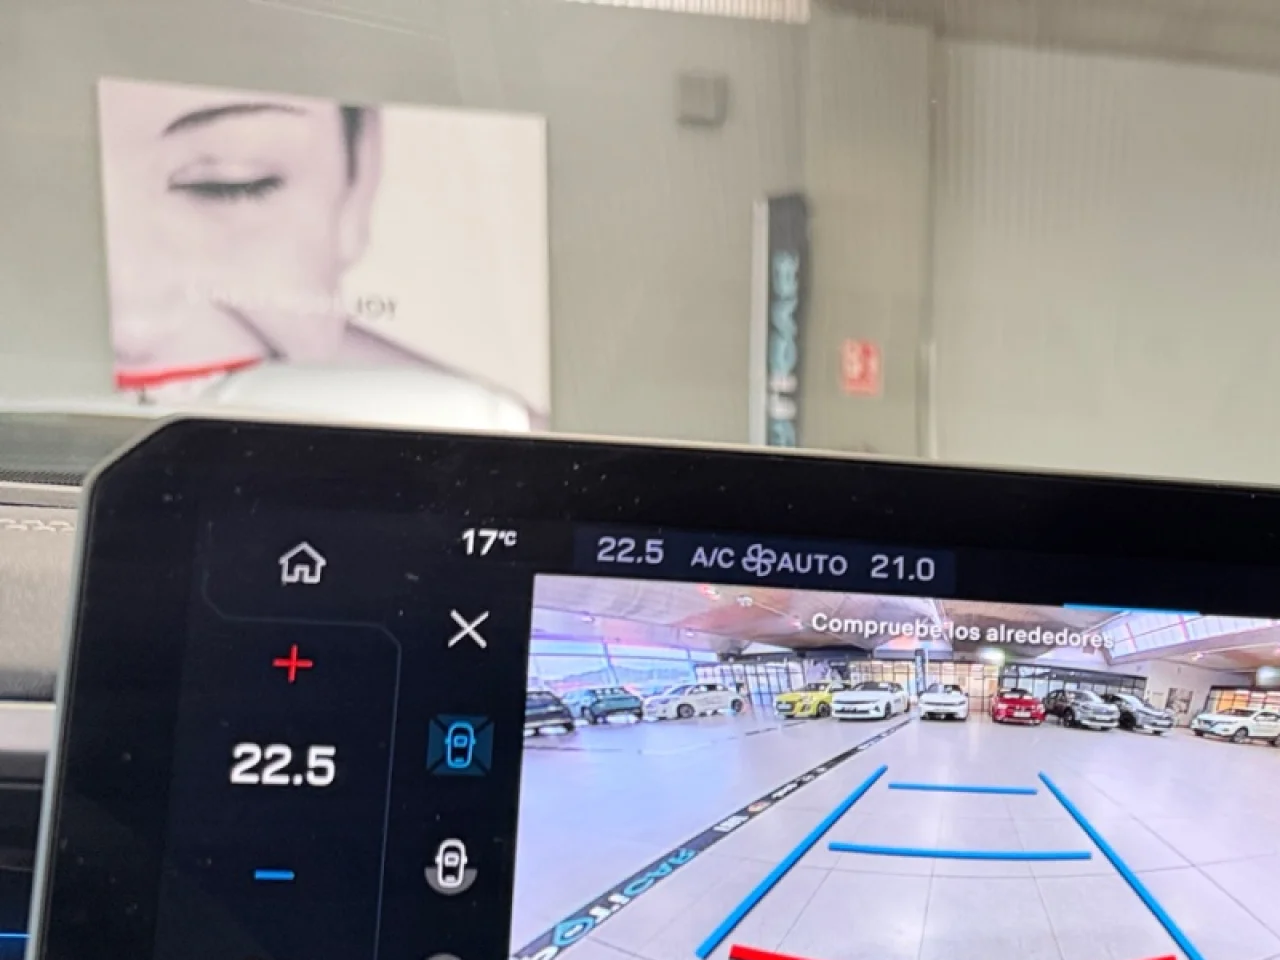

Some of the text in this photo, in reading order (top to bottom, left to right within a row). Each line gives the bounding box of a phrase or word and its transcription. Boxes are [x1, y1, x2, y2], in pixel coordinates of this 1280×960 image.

[597, 535, 665, 565] 22.5
[690, 546, 848, 577] A/C AUTO
[870, 553, 936, 582] 21.0
[811, 612, 1115, 650] Compruebe los alrededores
[230, 741, 337, 787] 22.5
